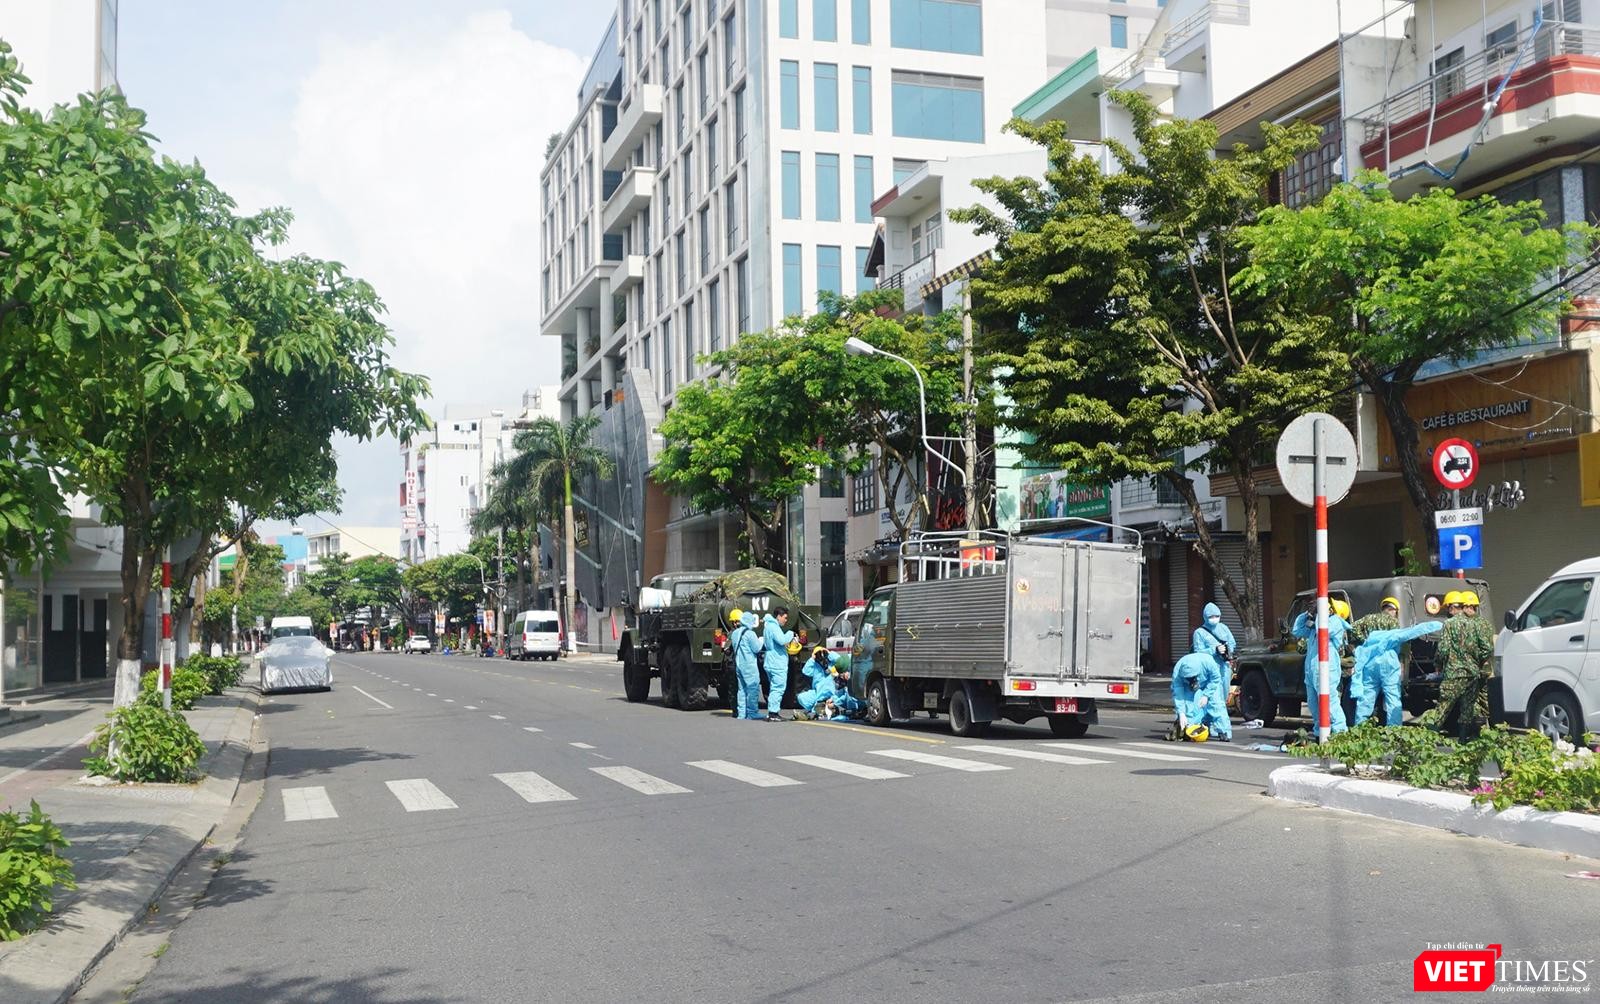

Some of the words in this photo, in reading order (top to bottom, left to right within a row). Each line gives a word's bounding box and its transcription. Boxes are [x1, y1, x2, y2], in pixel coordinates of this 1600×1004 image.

[1422, 411, 1447, 430] CAFÉ
[1448, 413, 1456, 426] &
[1457, 399, 1530, 423] RESTAURANT
[407, 471, 415, 505] HOTEL
[1438, 488, 1477, 508] Bad
[1495, 480, 1525, 510] Life
[1440, 515, 1456, 524] 06:00
[1462, 512, 1479, 522] 22:00
[1453, 534, 1473, 560] P
[751, 596, 770, 611] KV
